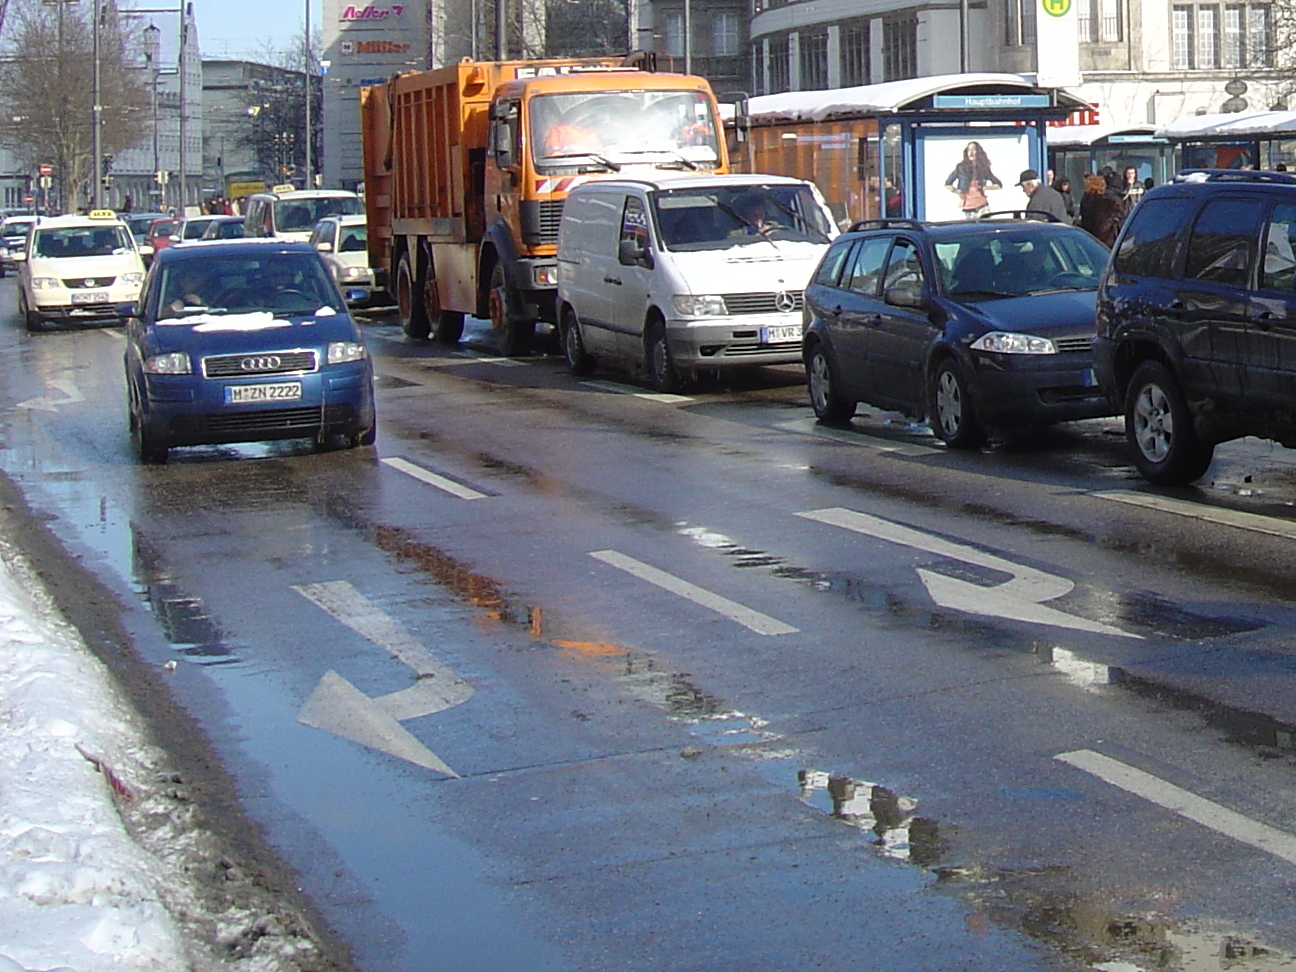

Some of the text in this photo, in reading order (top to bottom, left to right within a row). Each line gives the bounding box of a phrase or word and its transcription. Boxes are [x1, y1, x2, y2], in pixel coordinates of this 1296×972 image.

[965, 97, 1022, 107] Hauptbahnhof
[768, 328, 775, 339] M
[781, 327, 795, 338] VR
[233, 385, 300, 401] M ZN 2222
